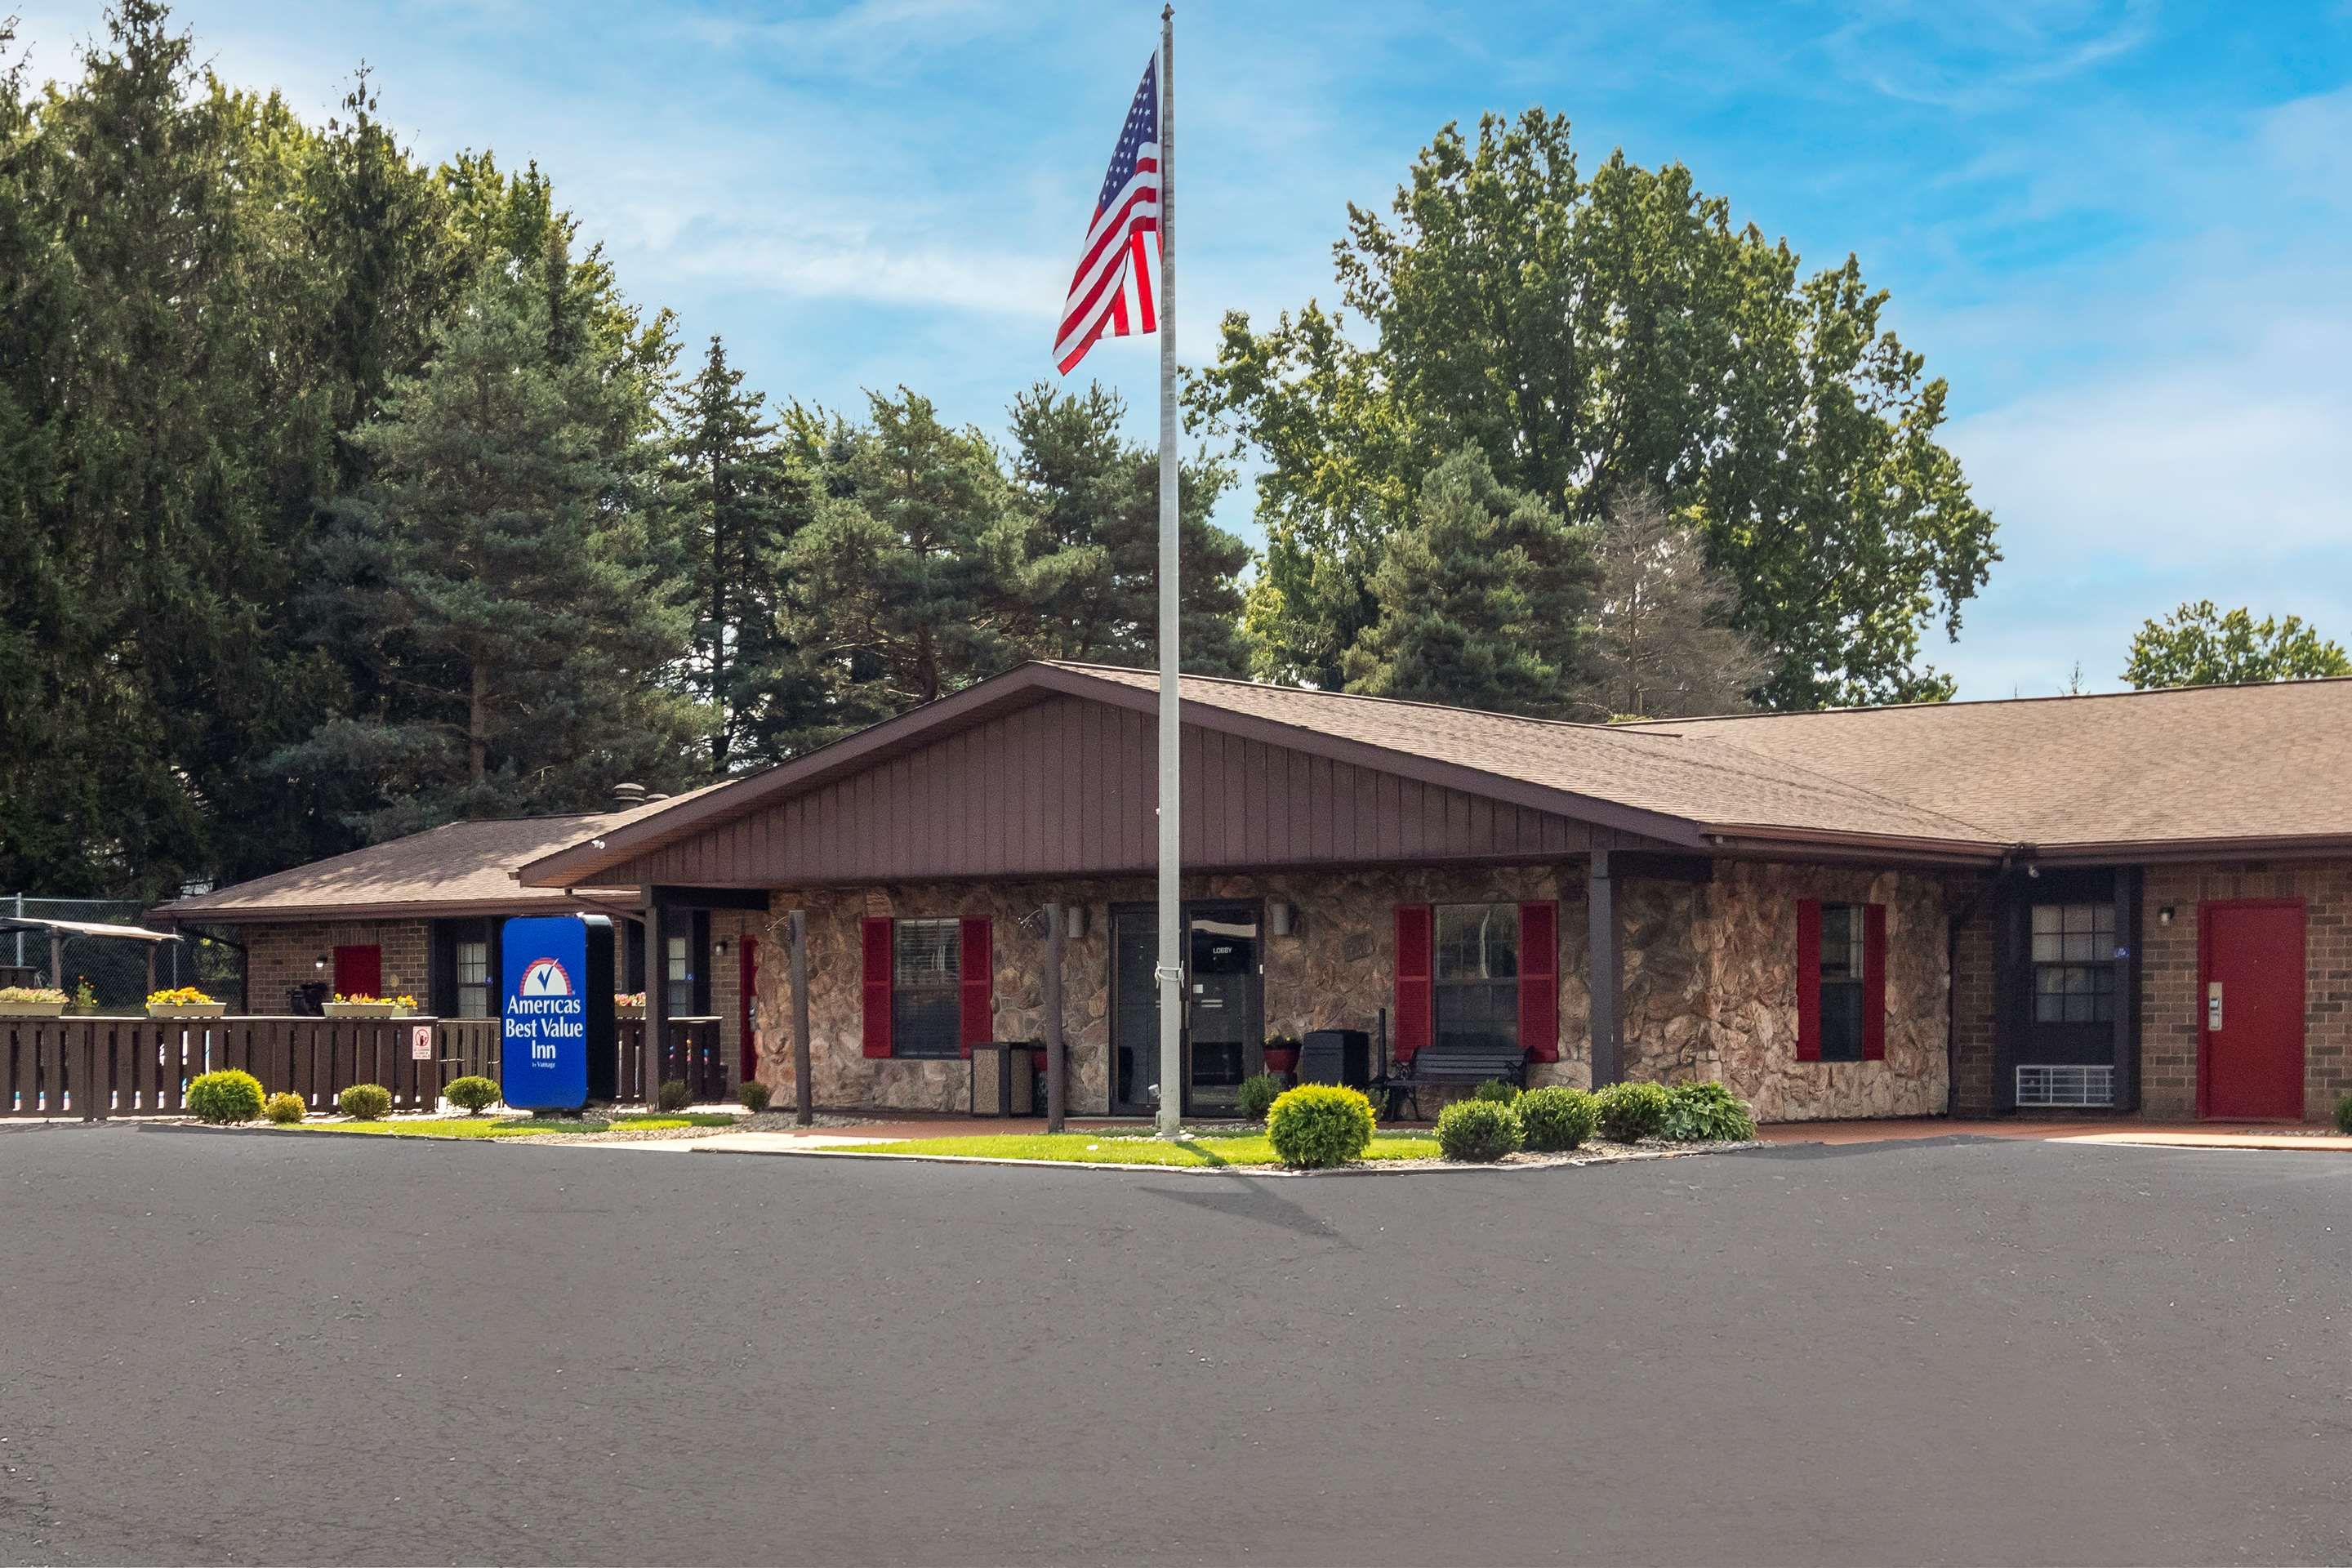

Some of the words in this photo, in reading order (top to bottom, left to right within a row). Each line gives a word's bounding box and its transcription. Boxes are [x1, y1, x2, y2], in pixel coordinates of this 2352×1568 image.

[507, 995, 581, 1014] Americas
[506, 1018, 537, 1037] Best
[541, 1016, 583, 1037] Value
[532, 1040, 555, 1059] Inn
